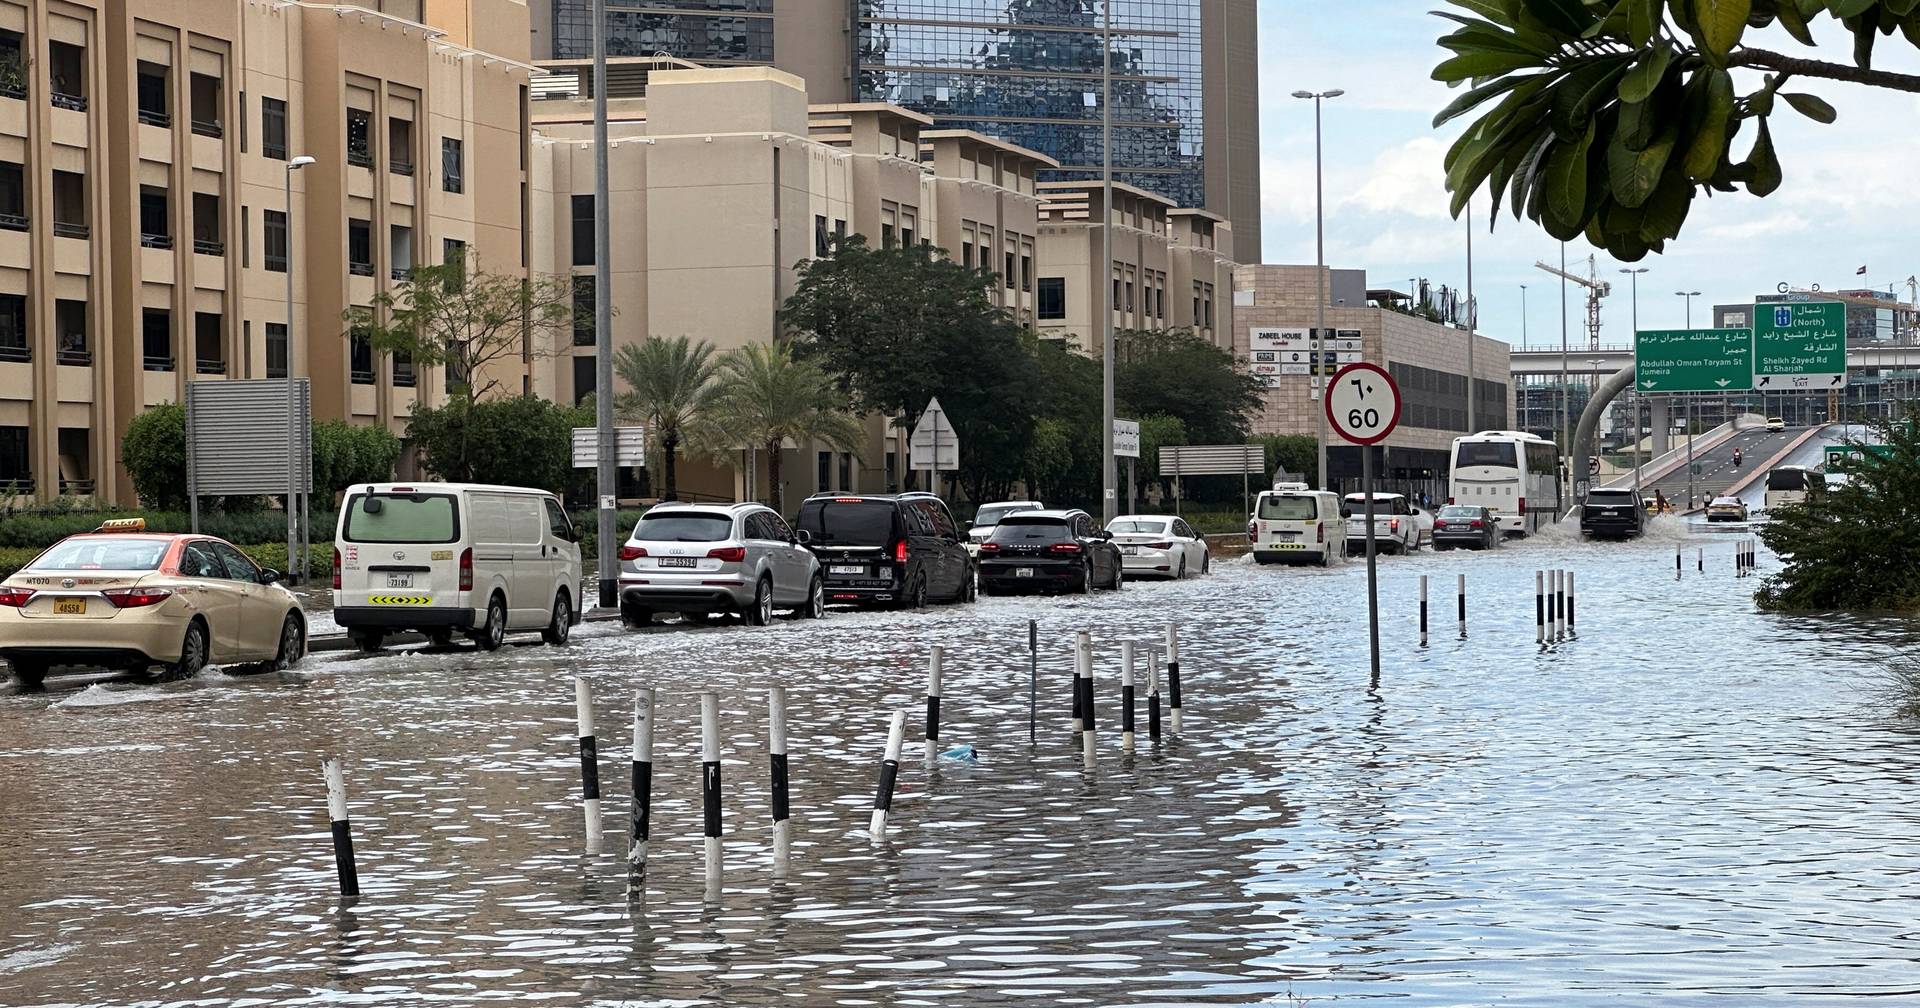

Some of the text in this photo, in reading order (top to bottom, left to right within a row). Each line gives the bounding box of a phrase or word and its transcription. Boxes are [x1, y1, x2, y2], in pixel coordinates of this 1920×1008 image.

[1793, 319, 1825, 327] (North)
[1660, 333, 1686, 343] عمران
[1689, 333, 1720, 342] عبدالله
[1725, 332, 1748, 342] شارع
[1783, 330, 1809, 341] الشيخ
[1814, 330, 1837, 340] شارع
[1804, 343, 1837, 353] الشارقة
[1640, 358, 1743, 368] Abdullah Omran Taryam St
[1763, 357, 1789, 365] Sheikh
[1791, 357, 1815, 365] Zayed
[1774, 365, 1804, 373] Sharjah
[1351, 379, 1373, 401] ٦٠
[1348, 408, 1379, 429] 60
